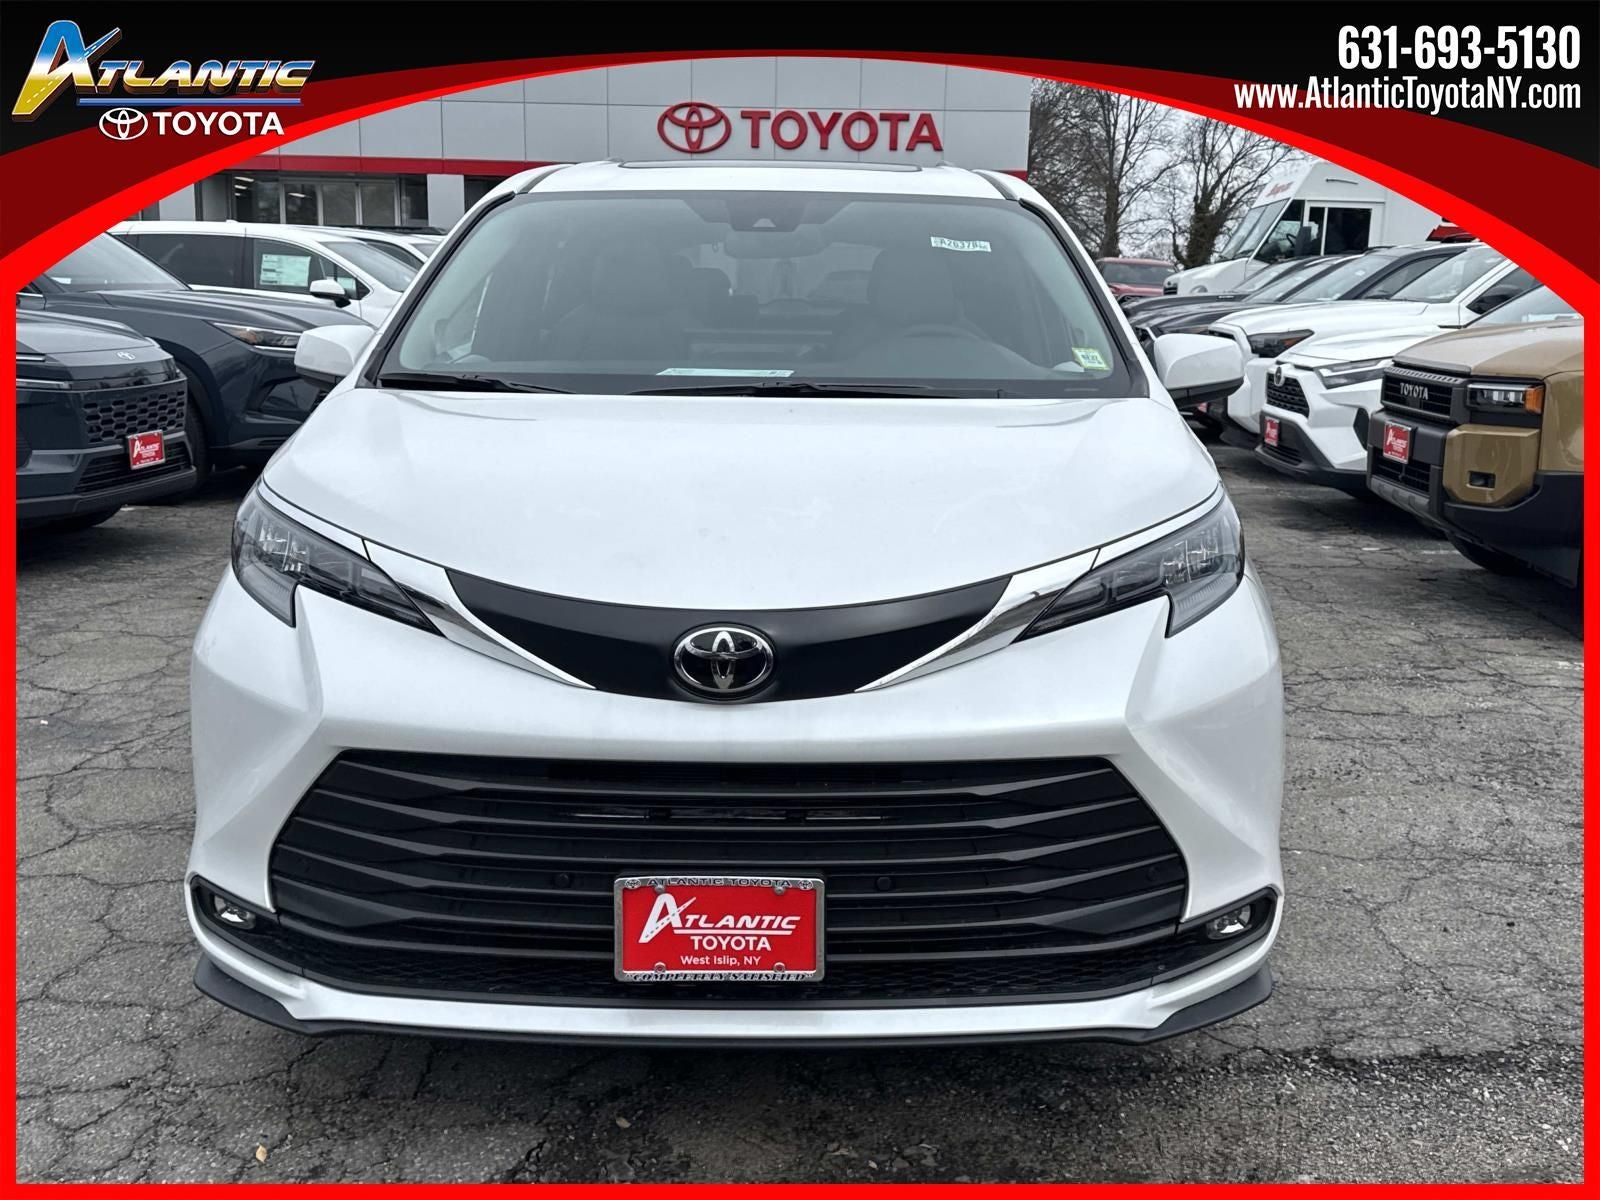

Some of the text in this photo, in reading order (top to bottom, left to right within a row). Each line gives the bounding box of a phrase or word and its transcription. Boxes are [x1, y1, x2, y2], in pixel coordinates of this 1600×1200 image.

[741, 110, 944, 151] TOYOTA
[1400, 382, 1429, 400] TOYOTA
[647, 877, 793, 888] ATLANTIC TOYOTA
[638, 892, 801, 943] ATLANTIC
[690, 935, 772, 951] TOYOTA
[680, 955, 761, 967] West Islip, NY
